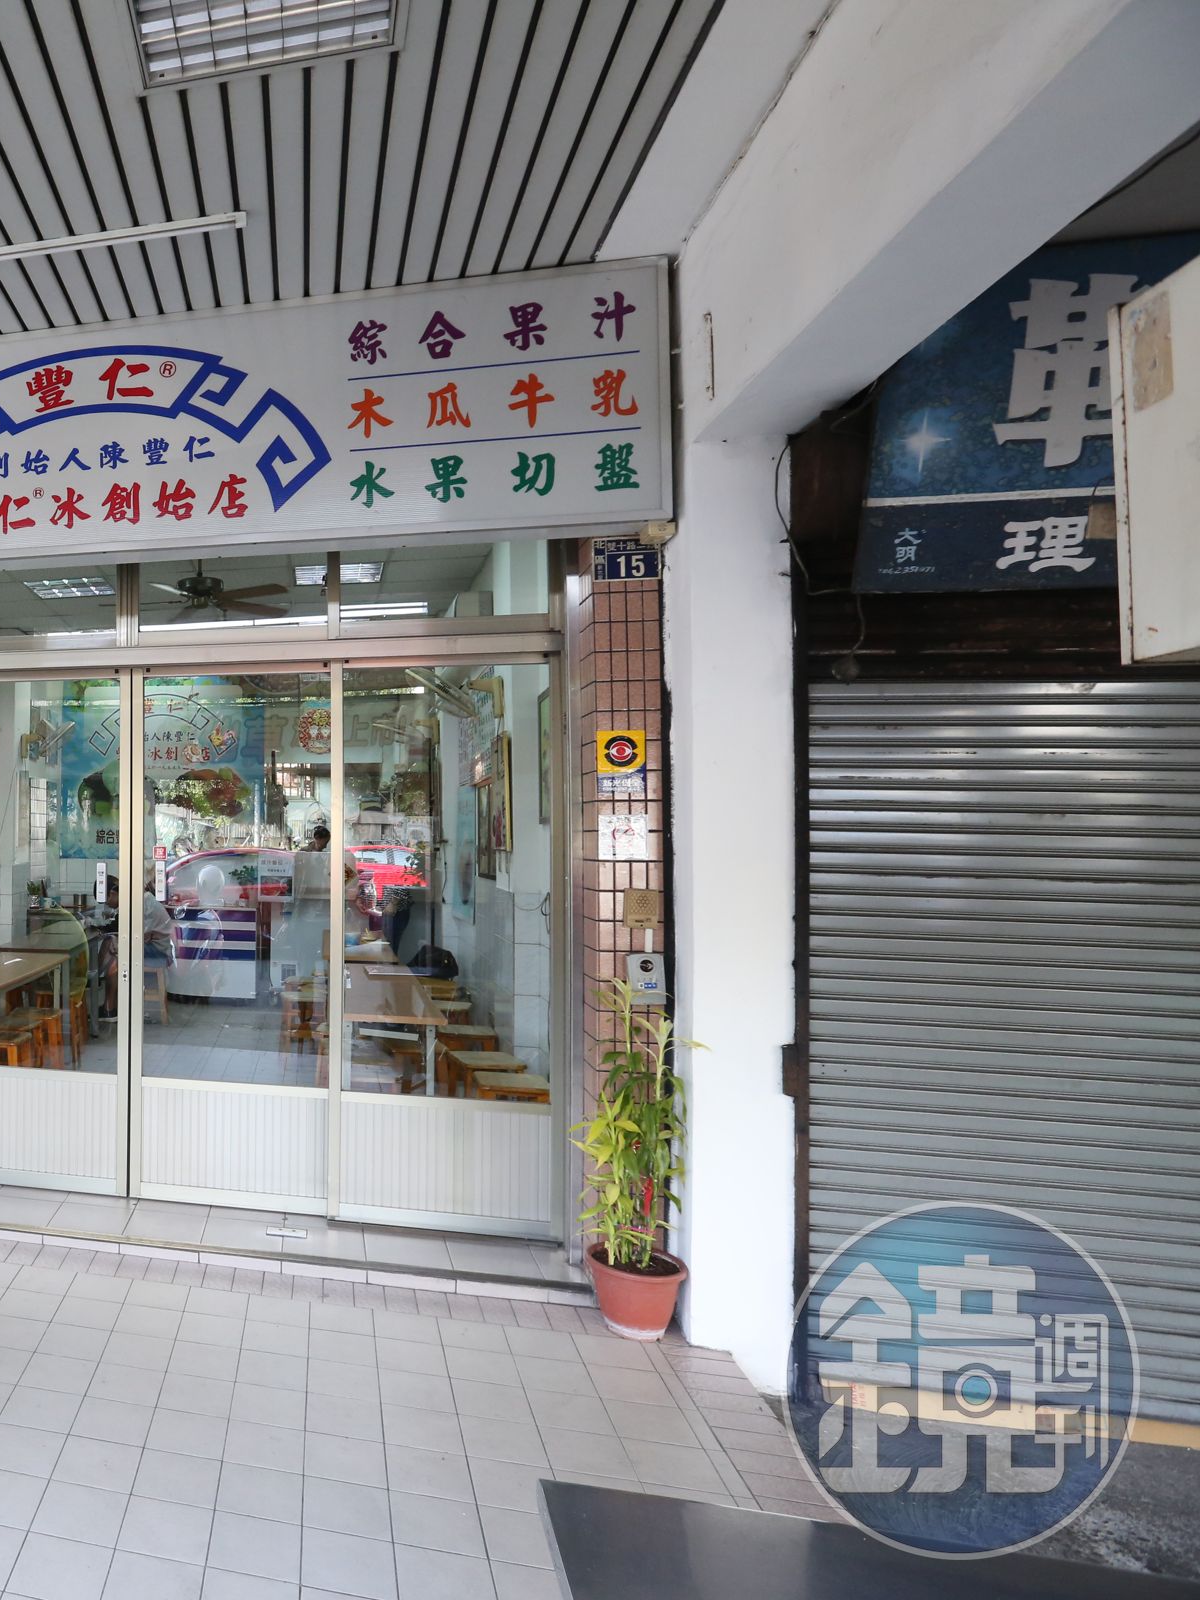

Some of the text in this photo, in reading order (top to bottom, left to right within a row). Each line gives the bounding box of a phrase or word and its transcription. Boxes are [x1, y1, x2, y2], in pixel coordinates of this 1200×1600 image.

[348, 292, 636, 365] 綜合果汁
[348, 369, 639, 438] 木瓜牛乳
[349, 442, 640, 508] 水果切盤
[616, 554, 645, 578] 15
[894, 527, 922, 563] 大明
[996, 516, 1097, 573] 理
[96, 828, 119, 844] 綜合
